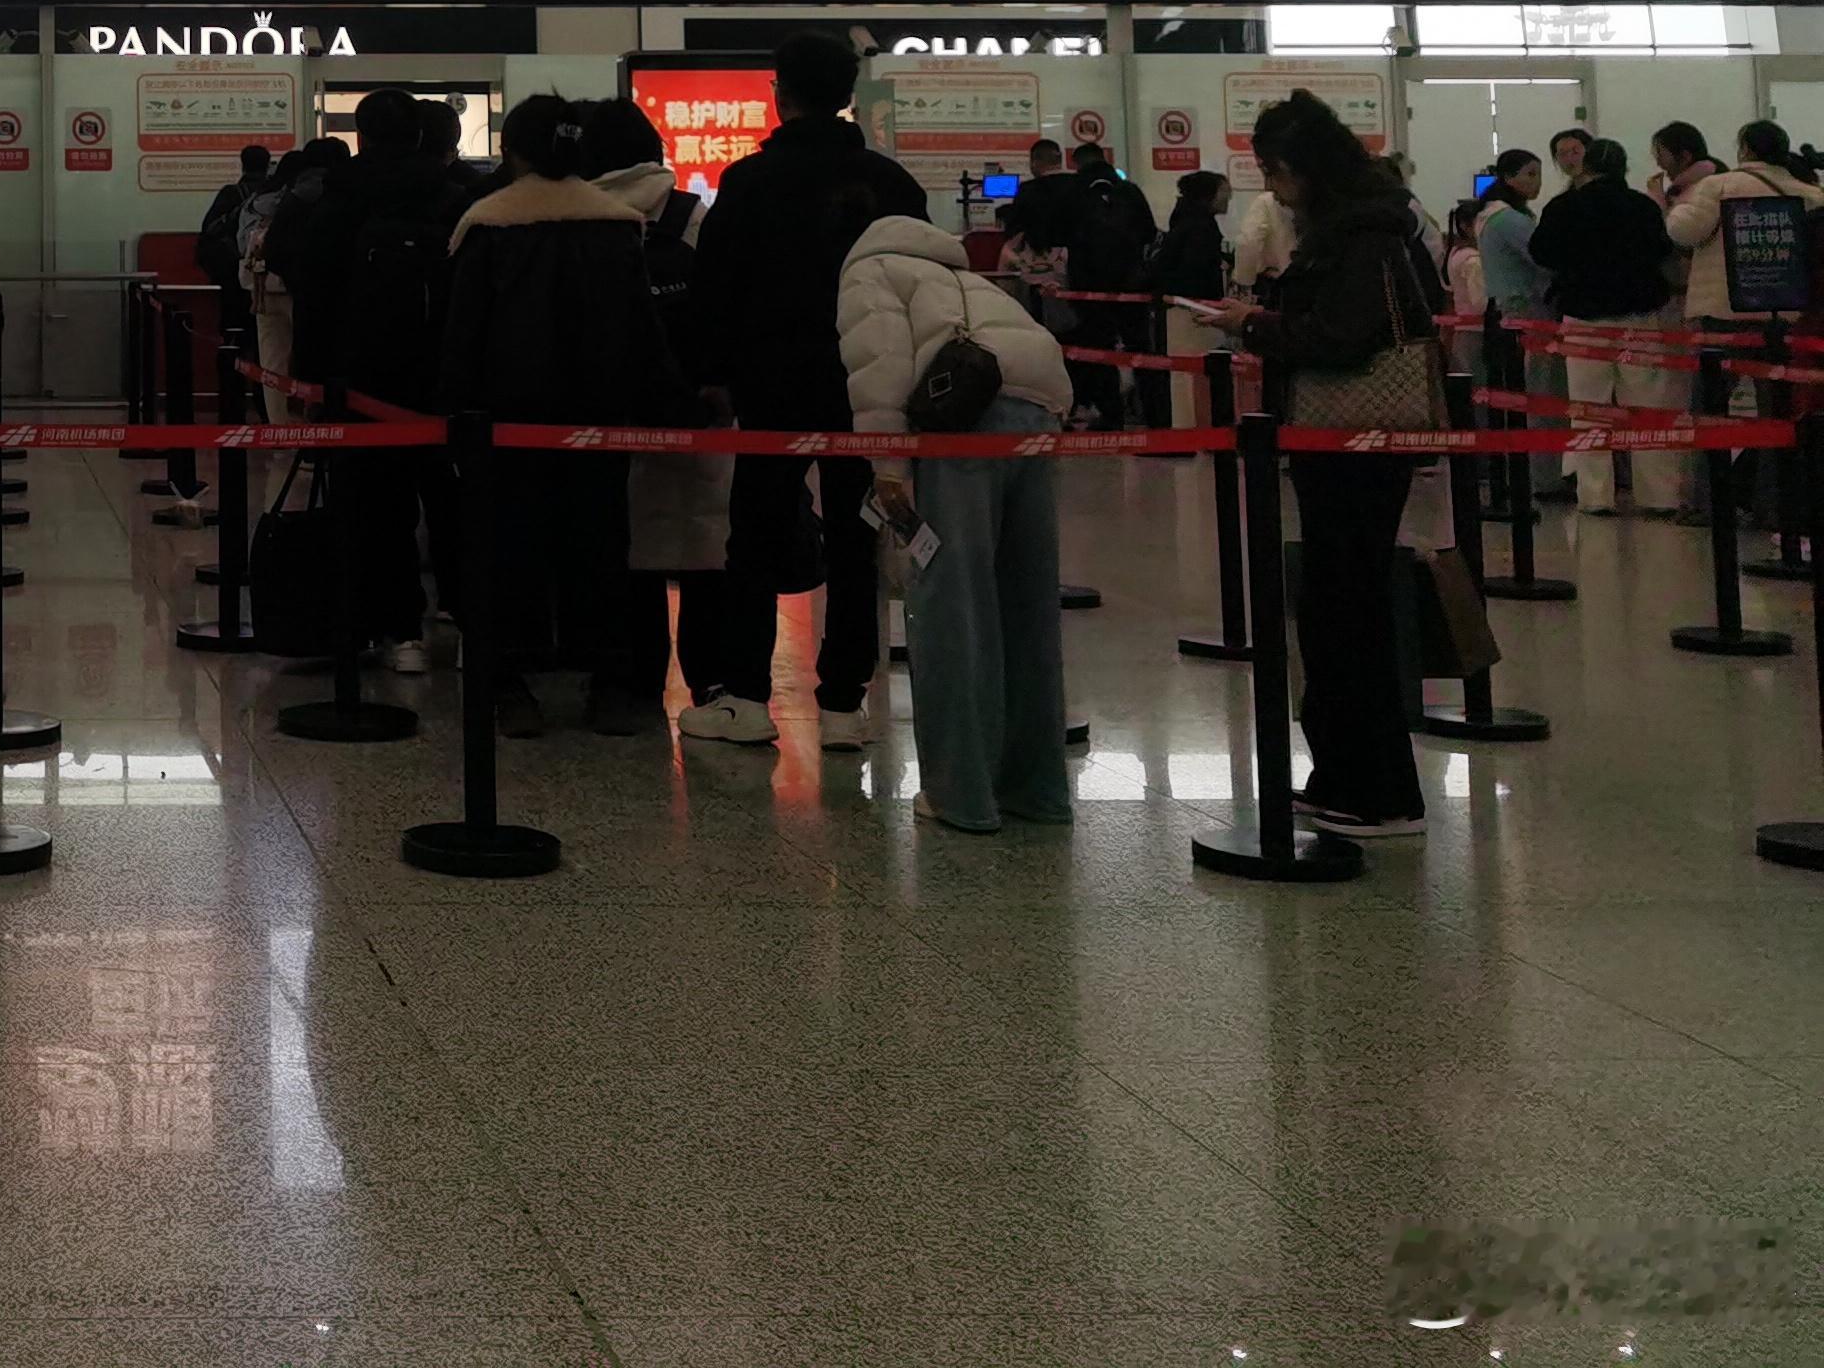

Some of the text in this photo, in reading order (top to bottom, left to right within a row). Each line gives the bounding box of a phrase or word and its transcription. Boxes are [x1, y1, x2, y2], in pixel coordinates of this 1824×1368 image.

[665, 101, 768, 130] 稳护财富
[41, 428, 125, 441] 河南机场集团
[260, 427, 344, 440] 河南机场集团
[607, 431, 692, 444] 河南机场集团
